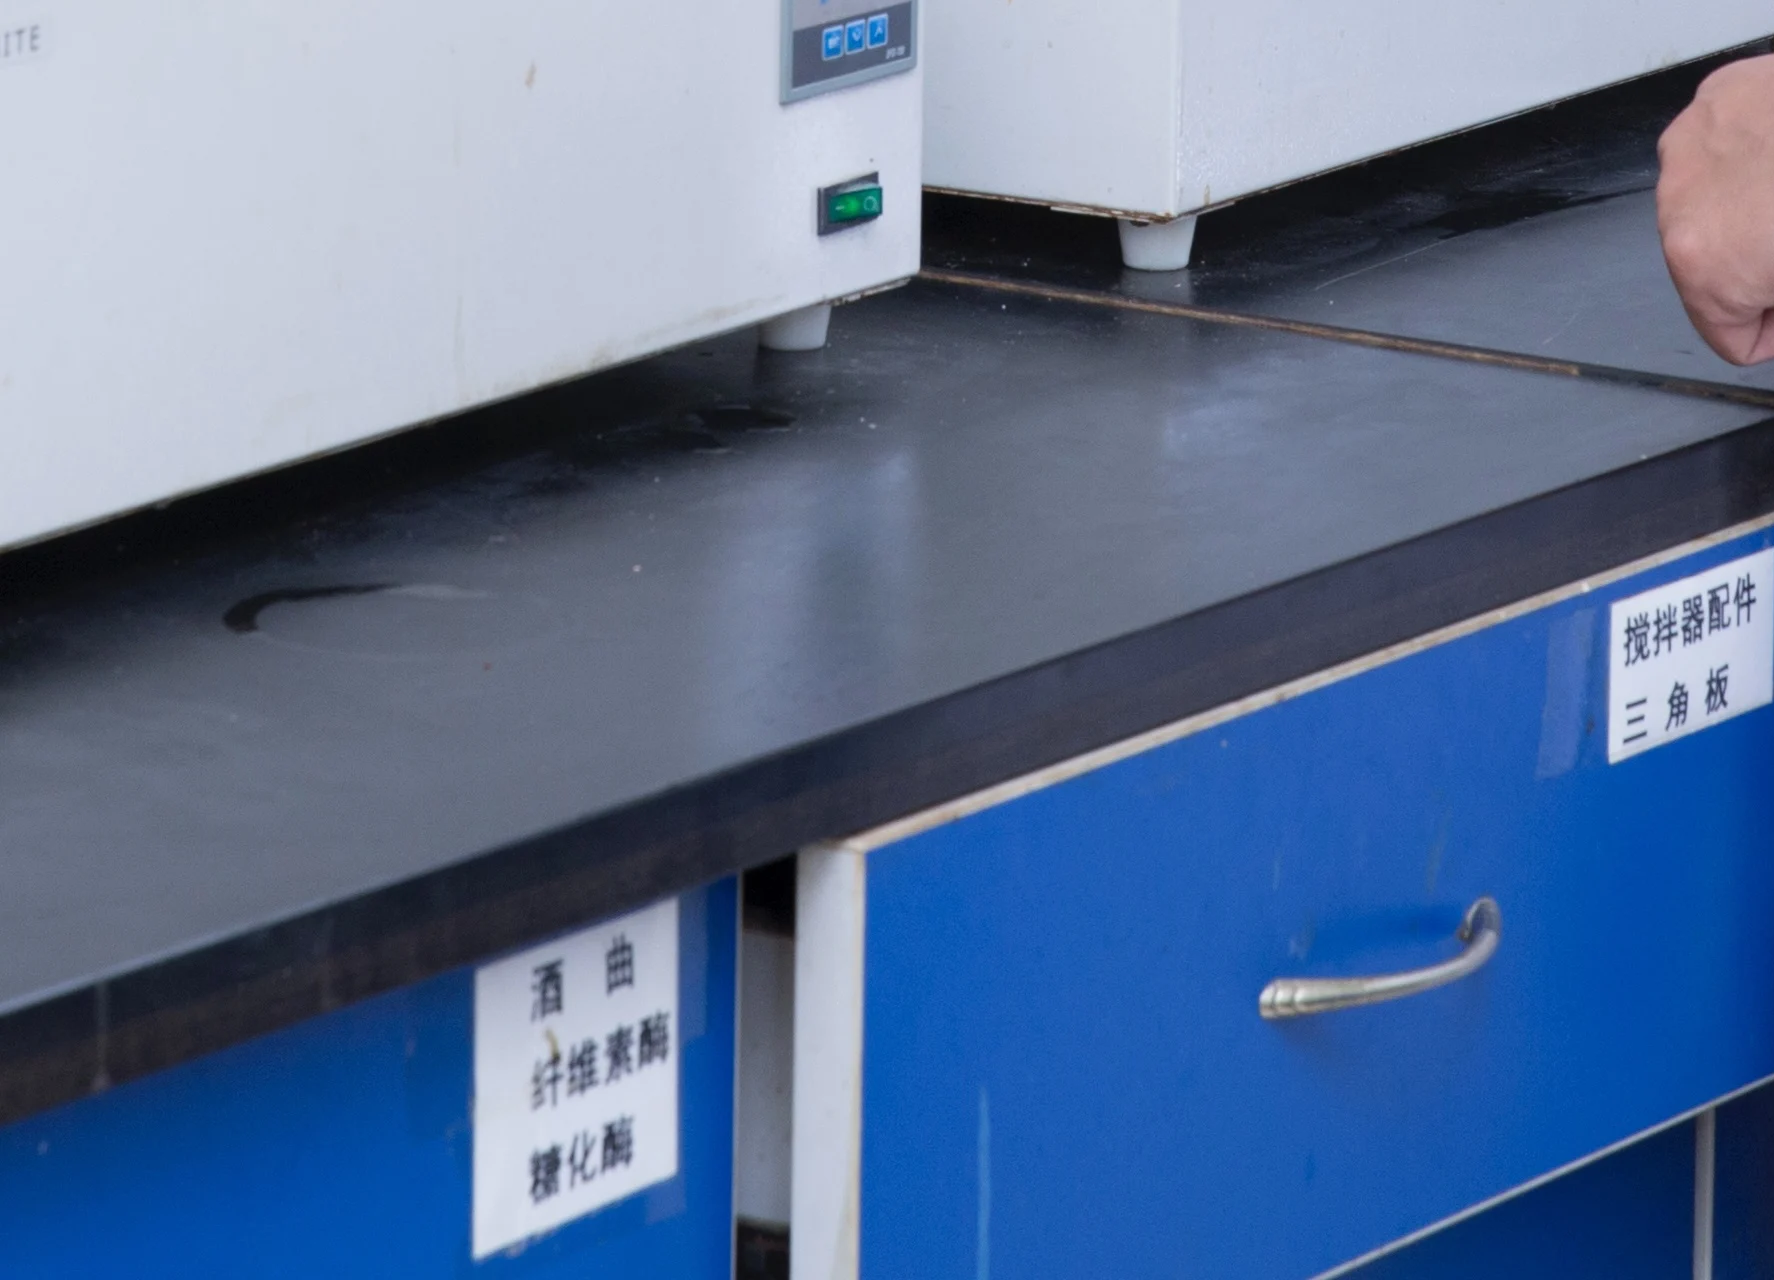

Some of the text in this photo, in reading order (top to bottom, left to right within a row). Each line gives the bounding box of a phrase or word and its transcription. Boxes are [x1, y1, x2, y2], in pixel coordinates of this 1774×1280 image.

[1623, 572, 1757, 668] 搅拌器配件
[1622, 663, 1730, 746] 三角板
[530, 931, 635, 1024] 酒曲
[529, 1008, 671, 1112] 纤维素酶
[528, 1114, 636, 1206] 糖化酶
